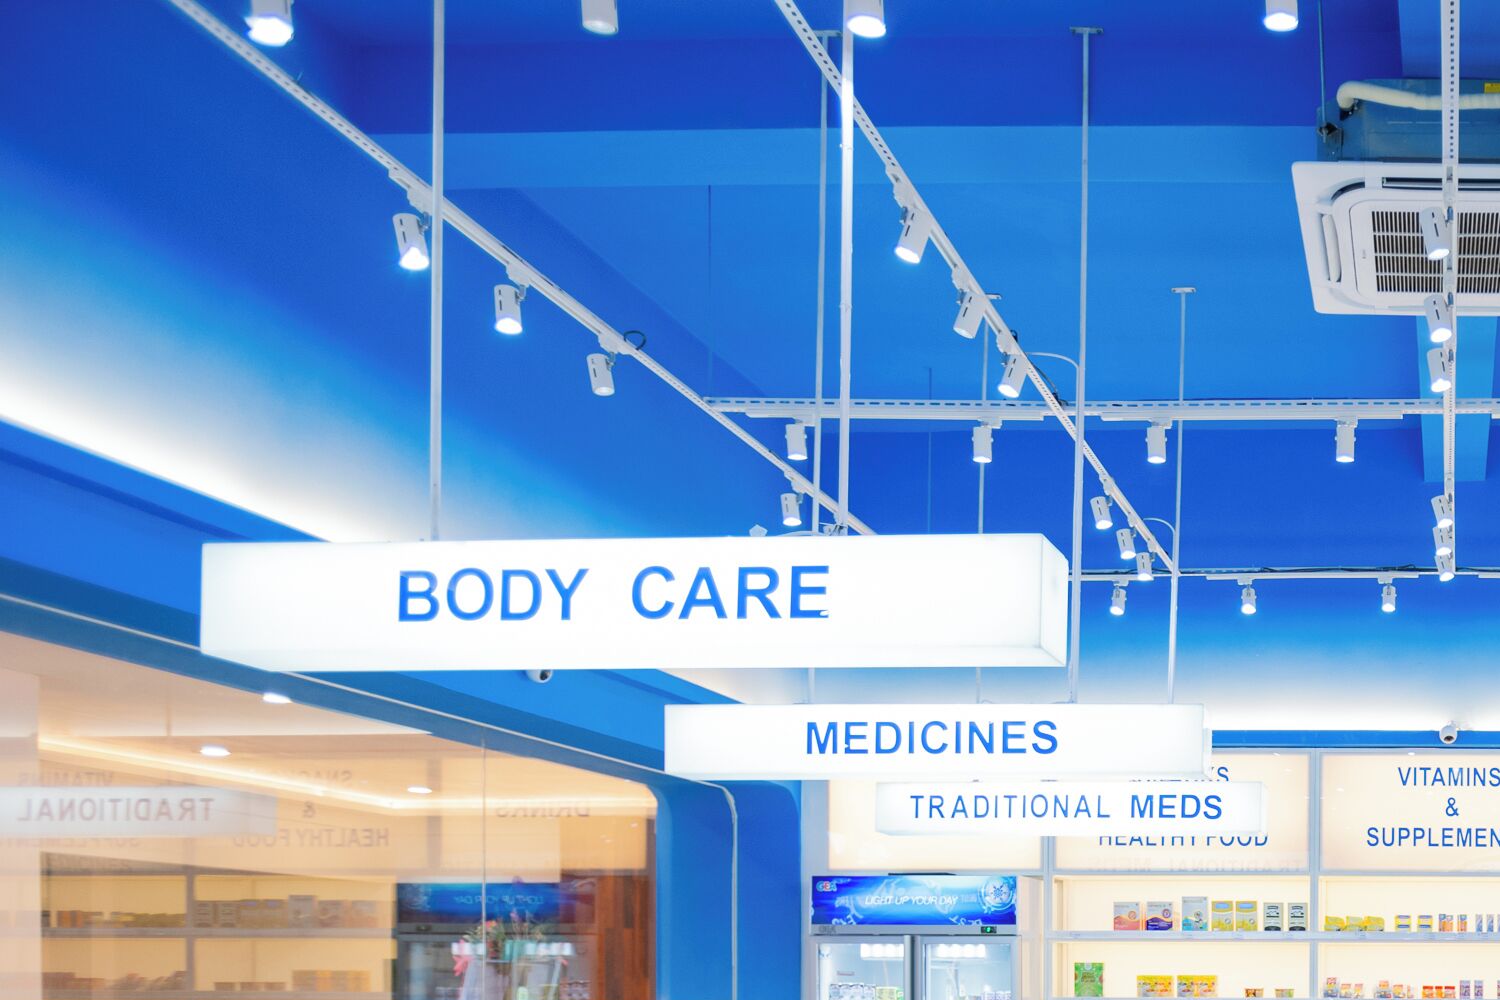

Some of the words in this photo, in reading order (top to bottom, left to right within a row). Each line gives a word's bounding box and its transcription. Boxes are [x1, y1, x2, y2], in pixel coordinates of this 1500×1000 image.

[398, 567, 588, 622] BODY
[631, 565, 830, 620] CARE
[806, 720, 1058, 755] MEDICINES
[910, 794, 1111, 819] TRADITIONAL
[1130, 794, 1222, 820] MEDS
[1445, 797, 1460, 817] &
[865, 895, 893, 905] LIGHT
[895, 896, 910, 905] UP
[910, 896, 938, 905] YOUR
[939, 896, 959, 905] DAY
